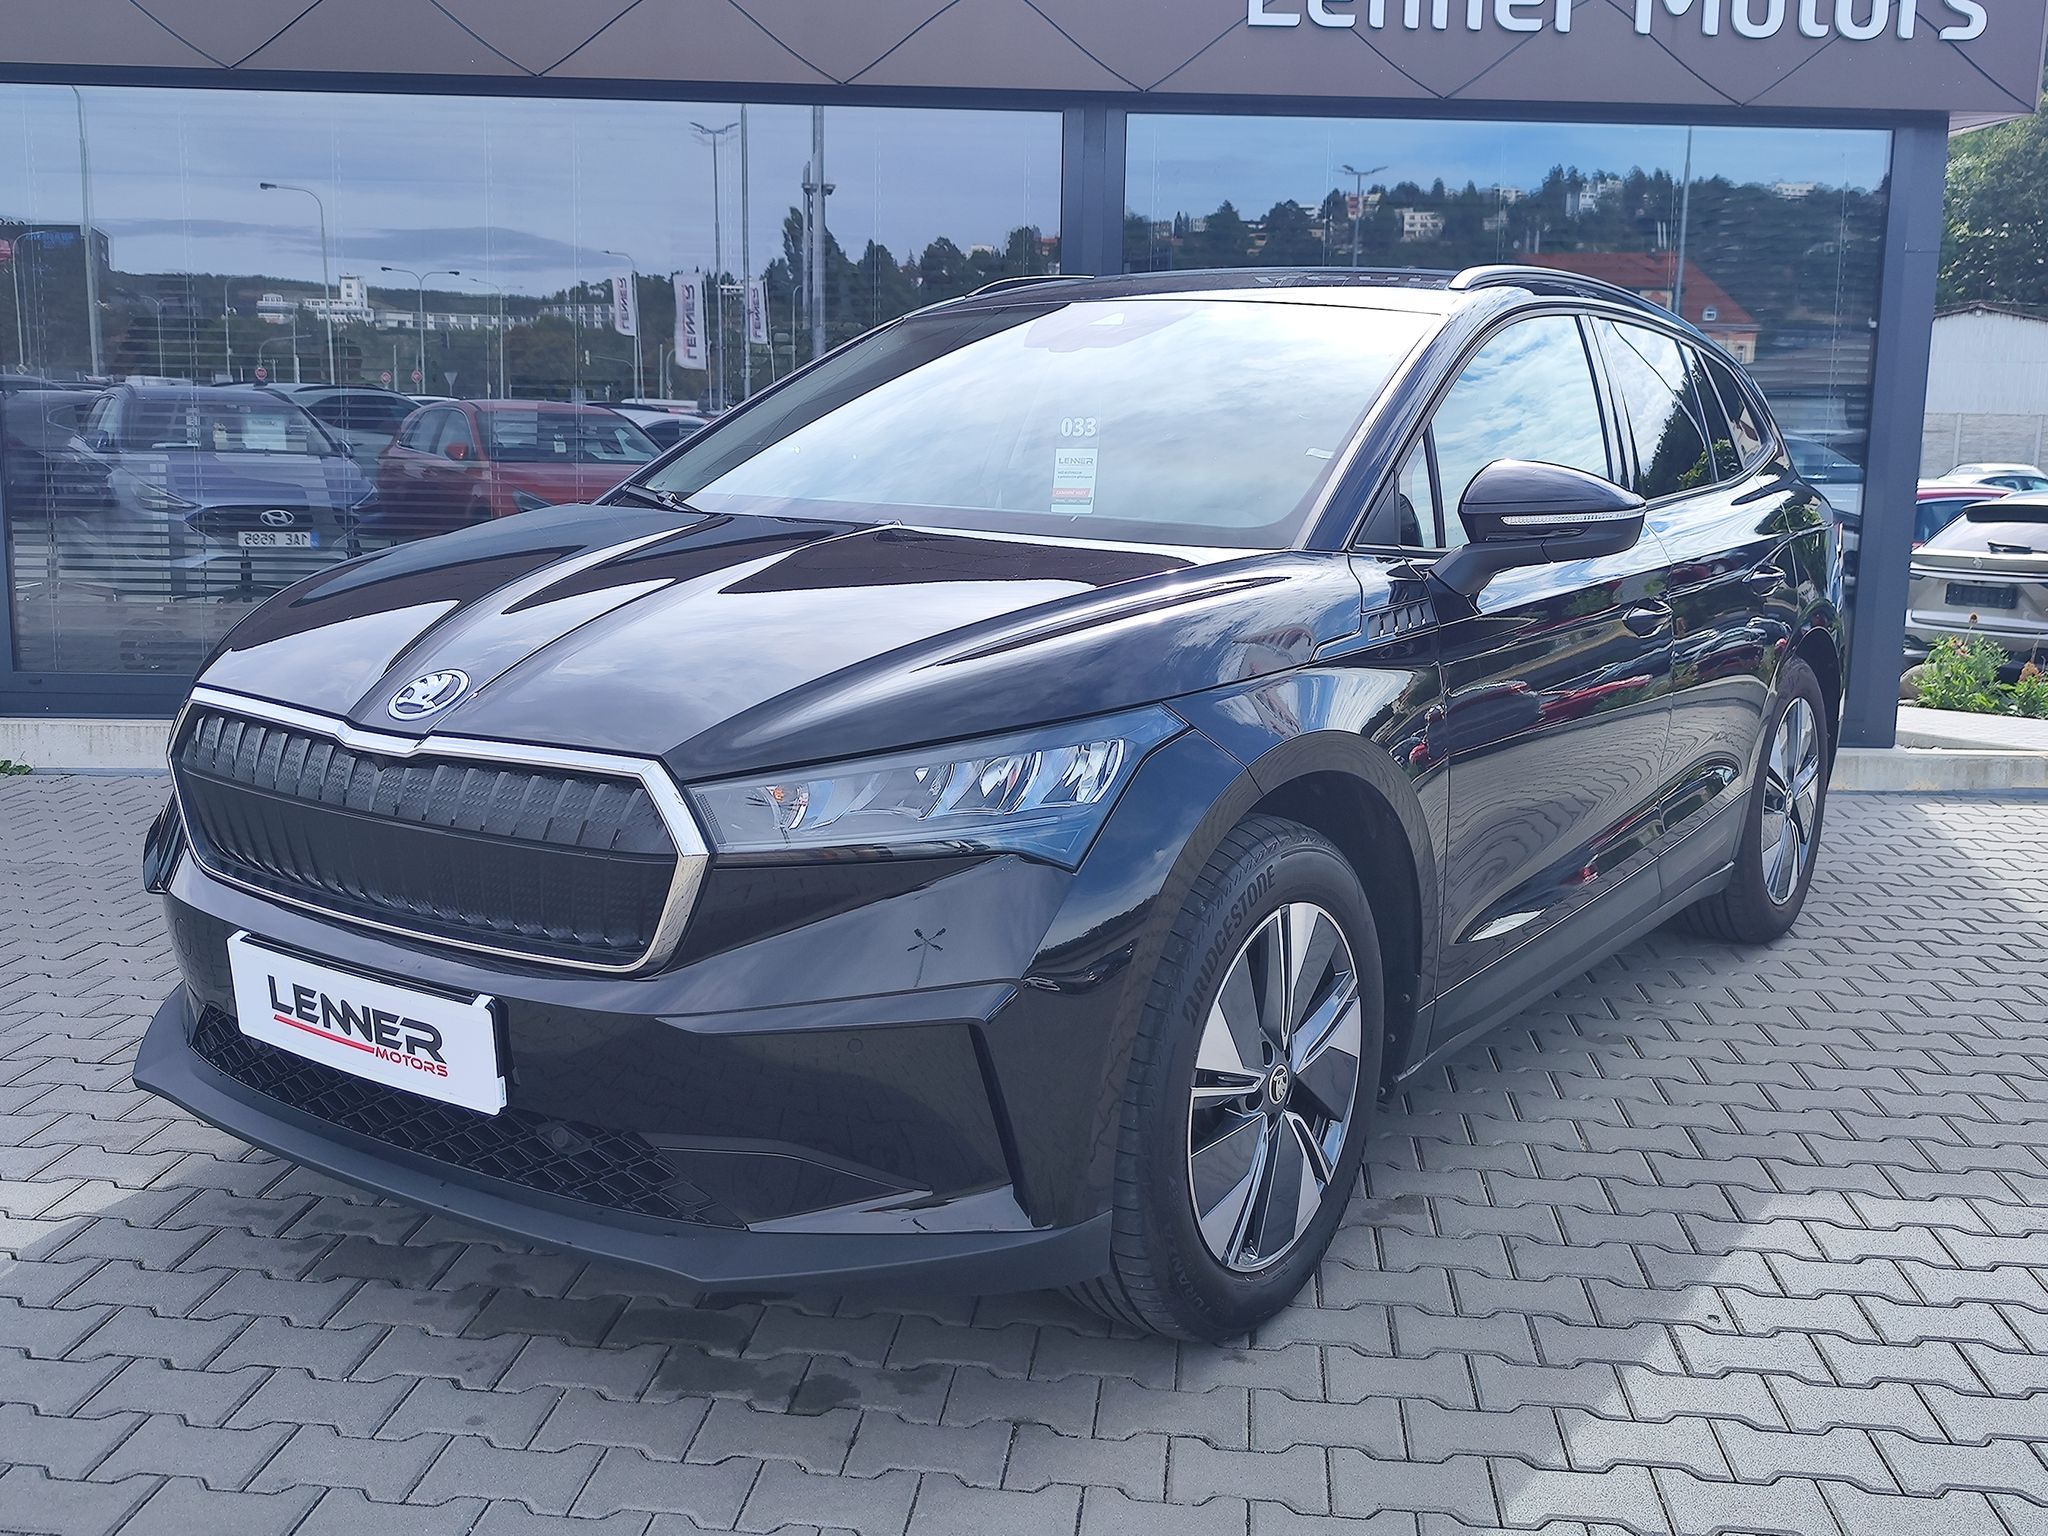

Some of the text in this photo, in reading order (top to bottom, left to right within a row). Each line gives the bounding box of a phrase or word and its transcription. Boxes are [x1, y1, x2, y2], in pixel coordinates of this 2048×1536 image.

[1060, 417, 1096, 437] 033
[1182, 863, 1277, 1028] BRIDGESTONE
[267, 974, 447, 1064] LENNER
[375, 1046, 449, 1078] MOTORS
